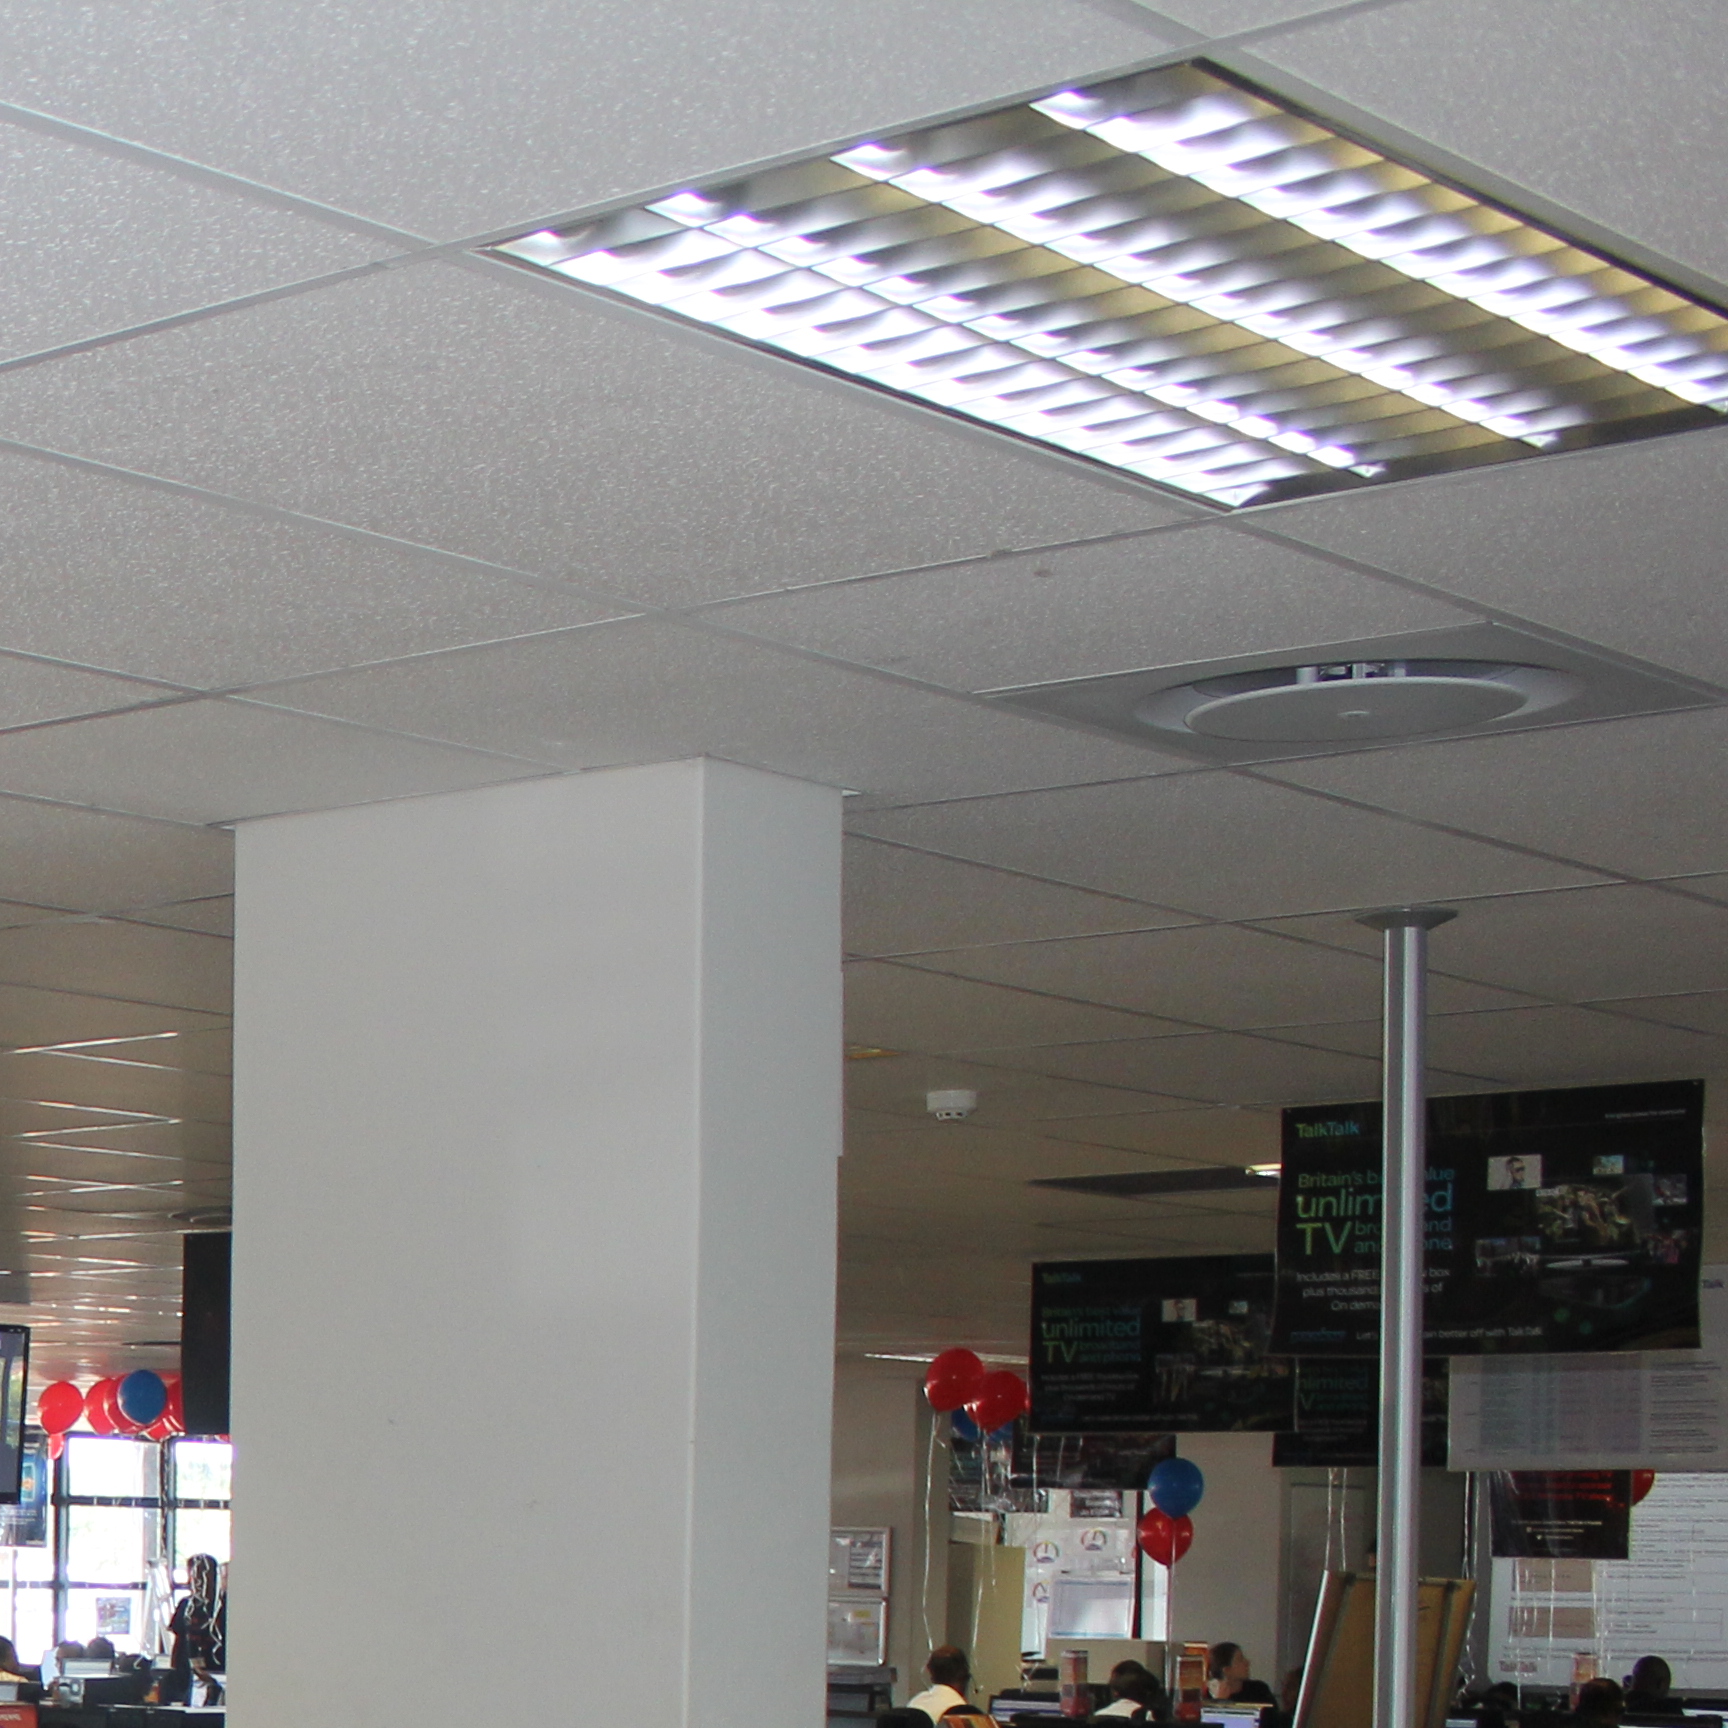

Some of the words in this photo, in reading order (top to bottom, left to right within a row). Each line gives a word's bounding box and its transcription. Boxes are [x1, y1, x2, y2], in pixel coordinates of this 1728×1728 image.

[1295, 1121, 1361, 1139] TalkTalk
[1298, 1170, 1363, 1188] Britain's
[1296, 1220, 1353, 1255] TV
[1326, 1283, 1381, 1297] thousand
[1041, 1315, 1141, 1340] unlimited
[1042, 1340, 1079, 1364] TV
[1298, 1366, 1369, 1390] nlimited
